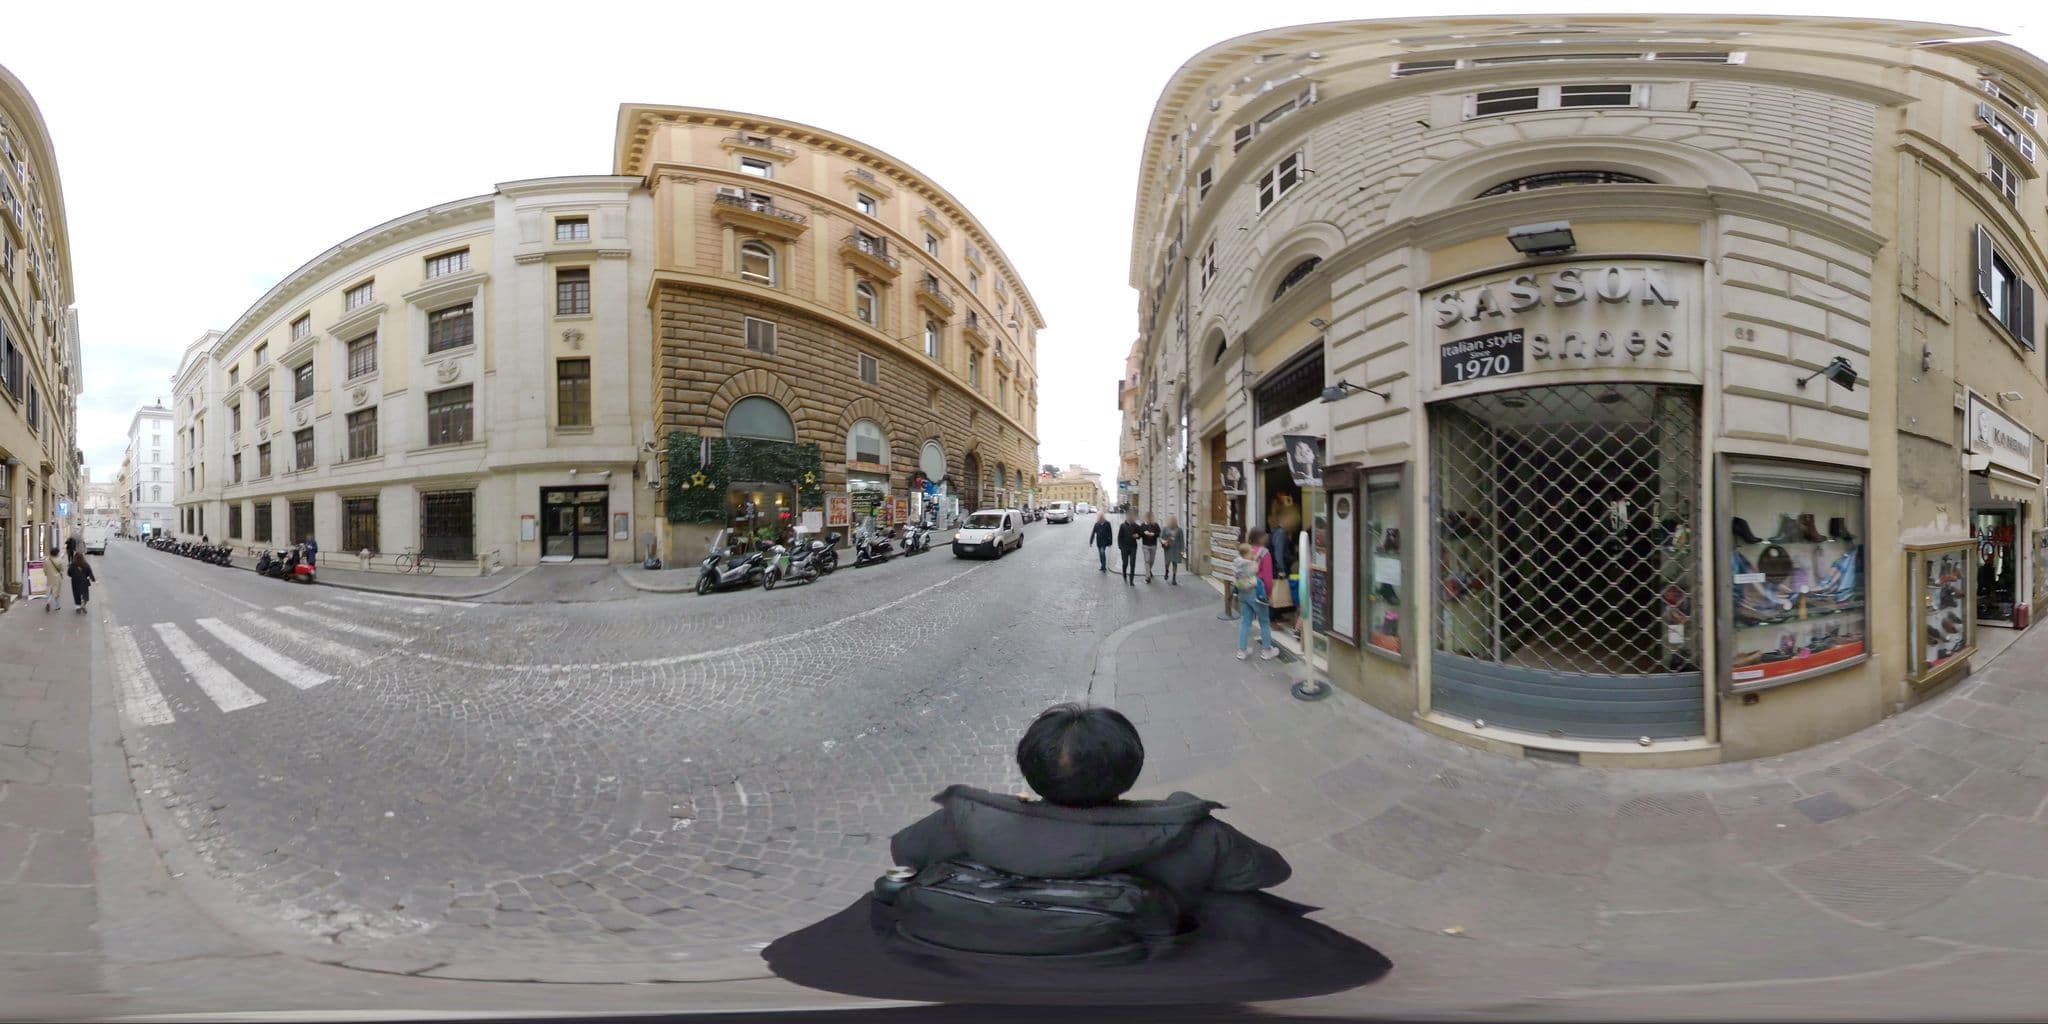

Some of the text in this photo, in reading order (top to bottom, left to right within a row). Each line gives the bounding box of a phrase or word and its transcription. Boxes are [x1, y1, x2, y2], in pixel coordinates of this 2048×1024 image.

[1434, 266, 1680, 329] SASSON
[1442, 331, 1522, 358] Italian style
[1532, 328, 1674, 361] shoes
[1454, 354, 1510, 381] 1970
